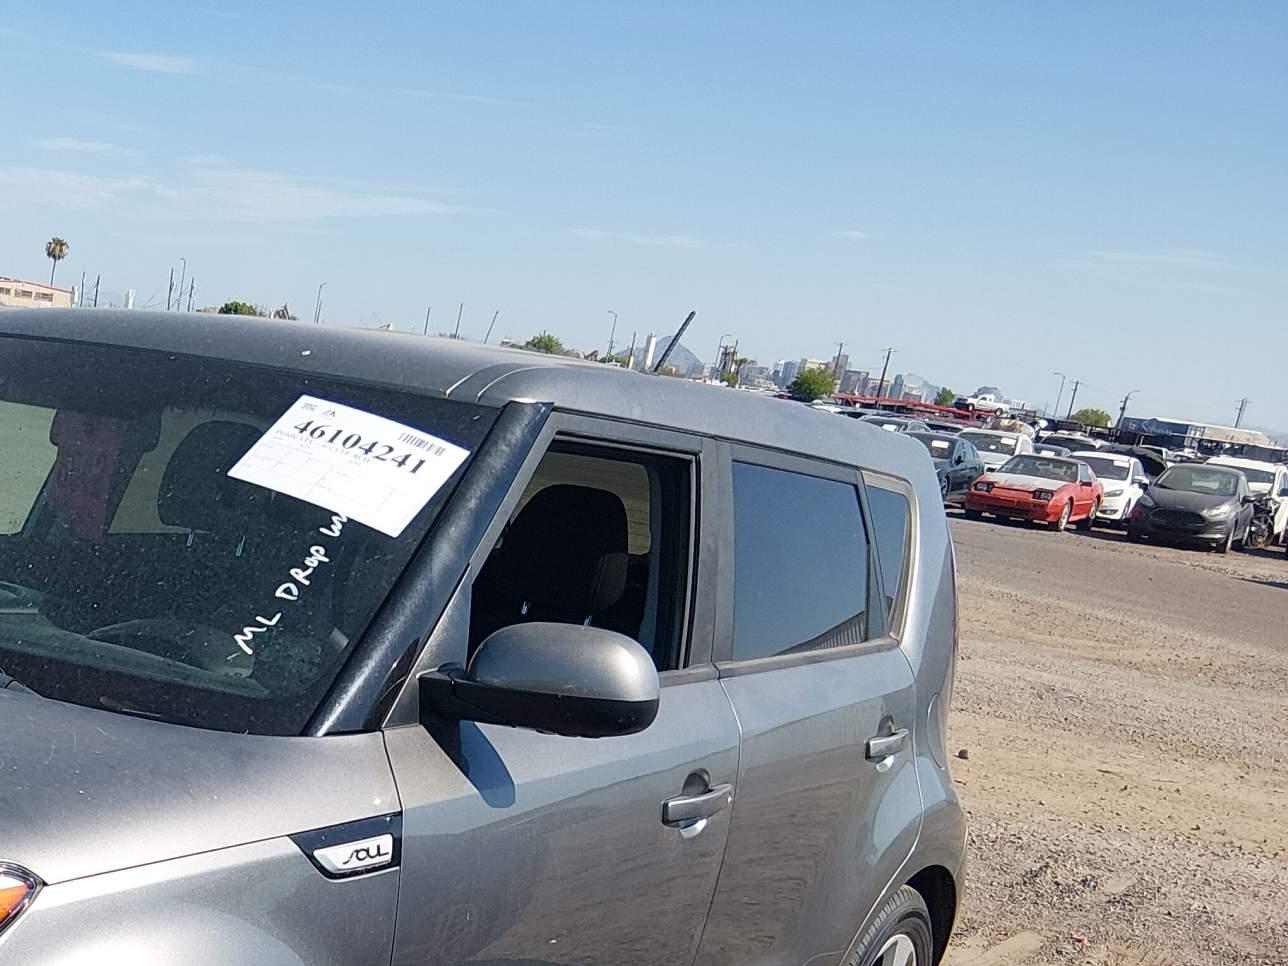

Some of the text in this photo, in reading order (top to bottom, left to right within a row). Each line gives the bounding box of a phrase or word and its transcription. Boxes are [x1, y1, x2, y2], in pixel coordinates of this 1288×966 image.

[294, 420, 427, 475] 46104241
[233, 612, 282, 655] ML
[341, 843, 390, 865] SOUL
